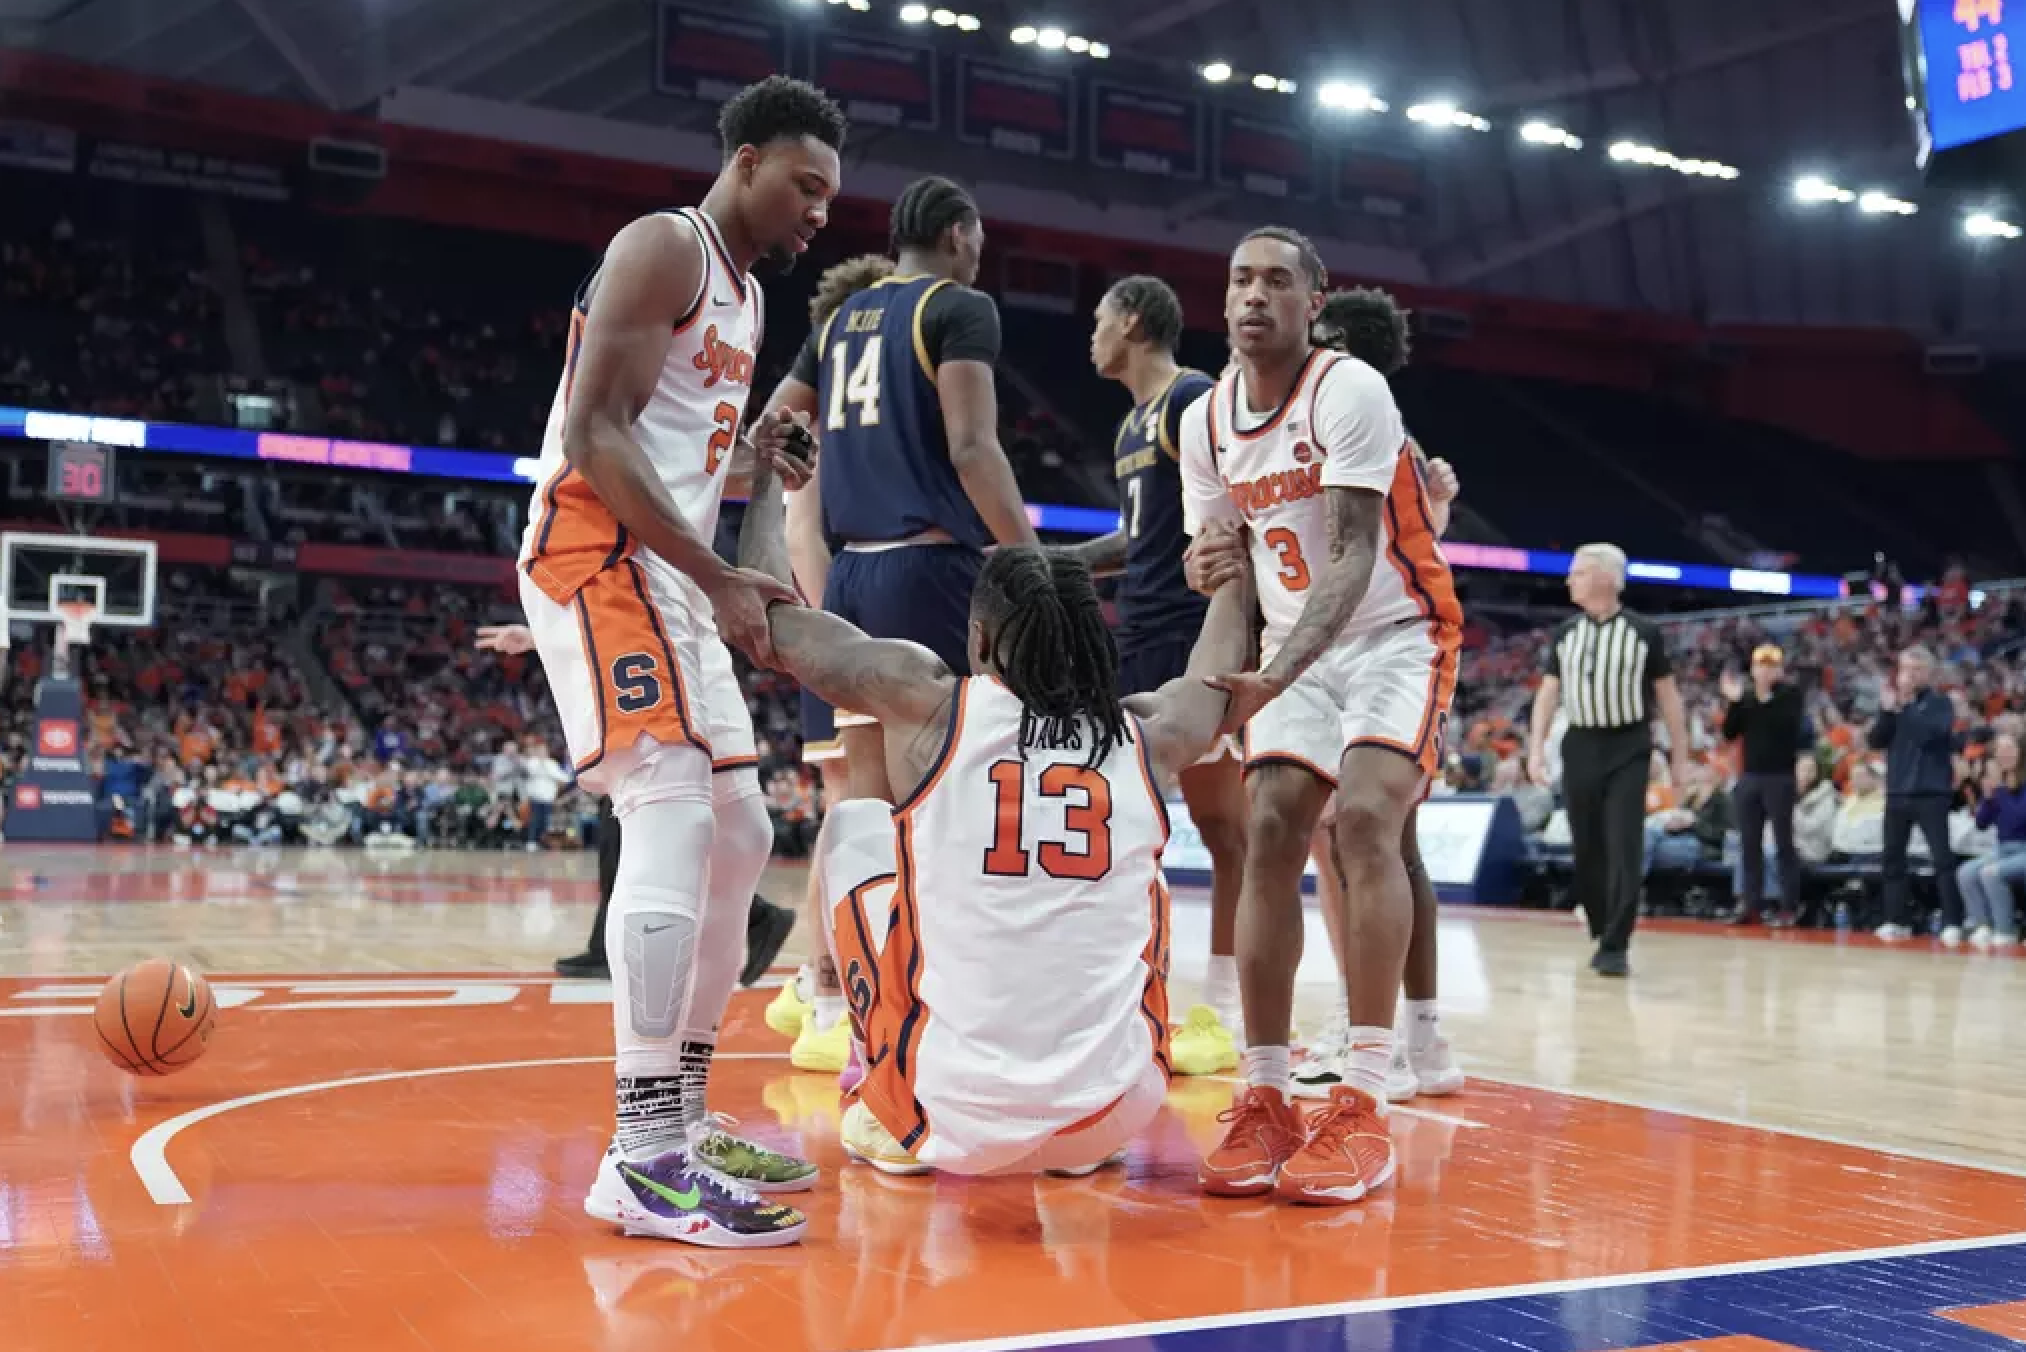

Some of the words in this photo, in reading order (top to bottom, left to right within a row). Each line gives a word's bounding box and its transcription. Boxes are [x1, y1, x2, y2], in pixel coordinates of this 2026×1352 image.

[827, 336, 882, 430] 14
[706, 400, 738, 476] 2
[63, 461, 102, 497] 30
[1264, 526, 1310, 592] 3
[610, 652, 662, 714] S
[983, 760, 1112, 881] 13
